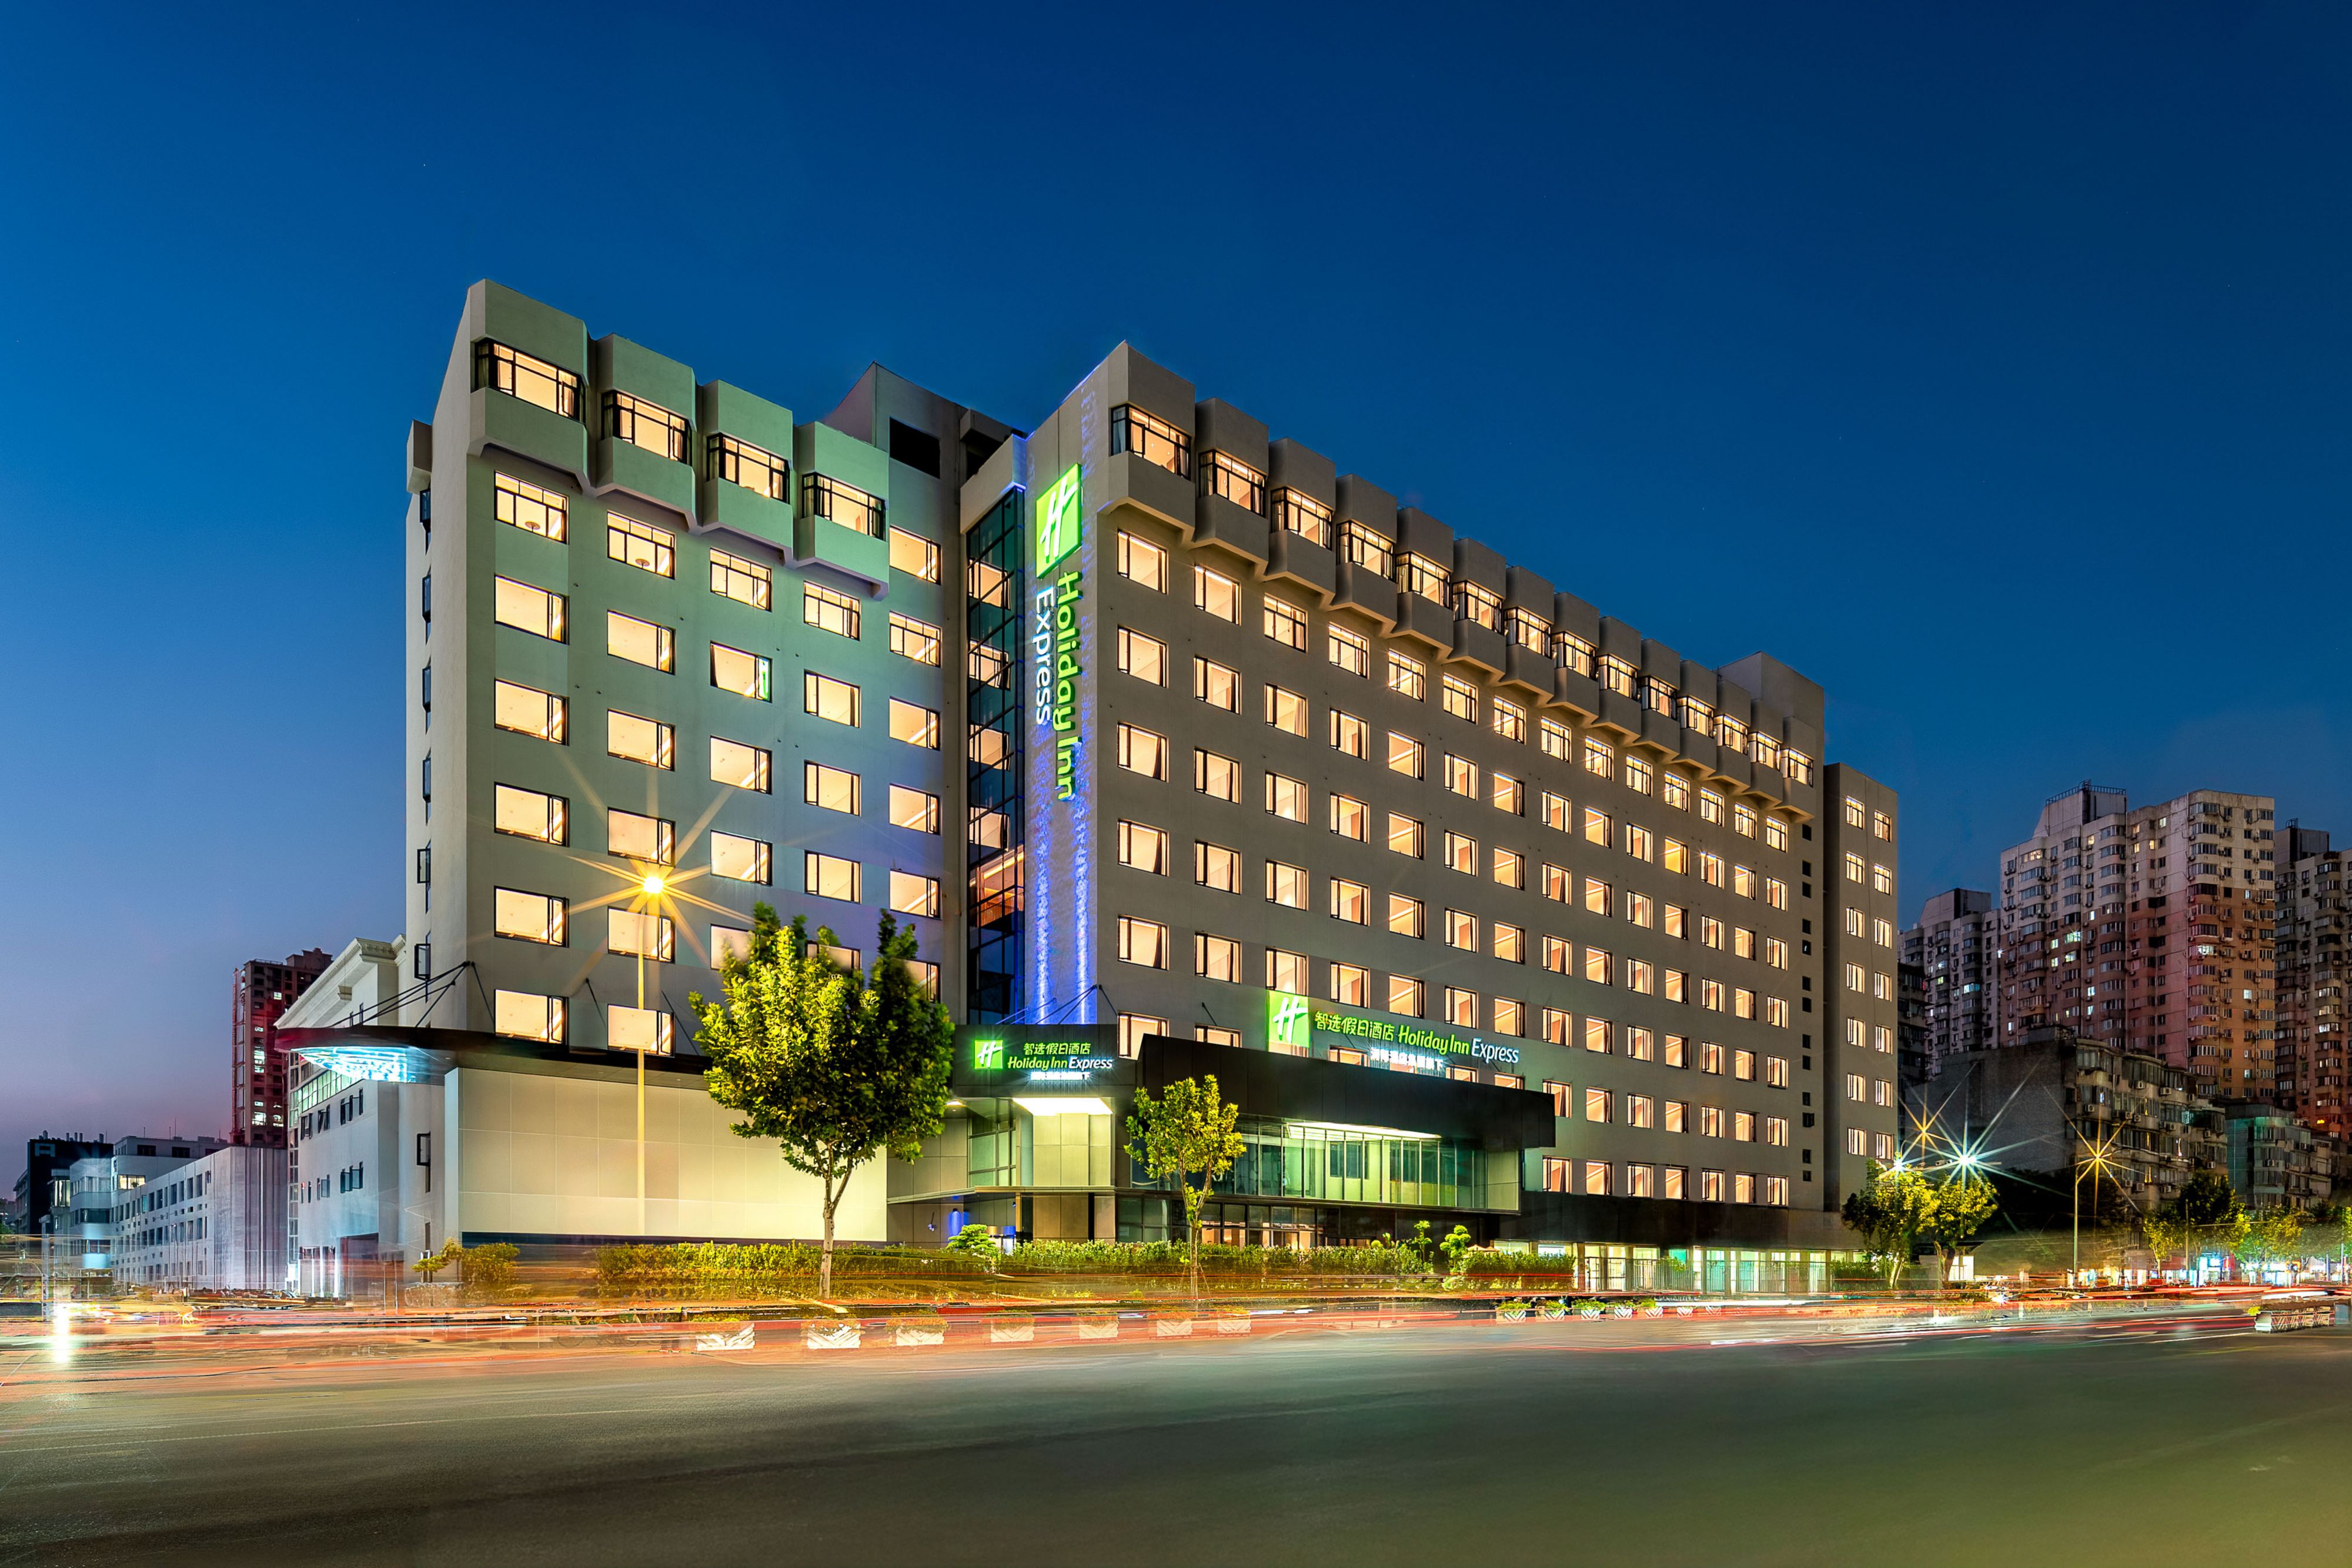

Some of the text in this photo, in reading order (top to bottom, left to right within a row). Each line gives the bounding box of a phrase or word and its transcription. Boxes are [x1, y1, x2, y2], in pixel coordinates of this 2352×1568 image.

[1033, 587, 1055, 725] Express
[1053, 571, 1081, 800] Holiday Inn
[1008, 1056, 1113, 1071] Holiday Inn Express
[1023, 1042, 1091, 1055] 智选假日酒店
[1315, 1011, 1395, 1041] 智选假日酒店
[1398, 1025, 1449, 1055] Holiday
[1450, 1034, 1469, 1055] Inn
[1471, 1038, 1519, 1064] Express
